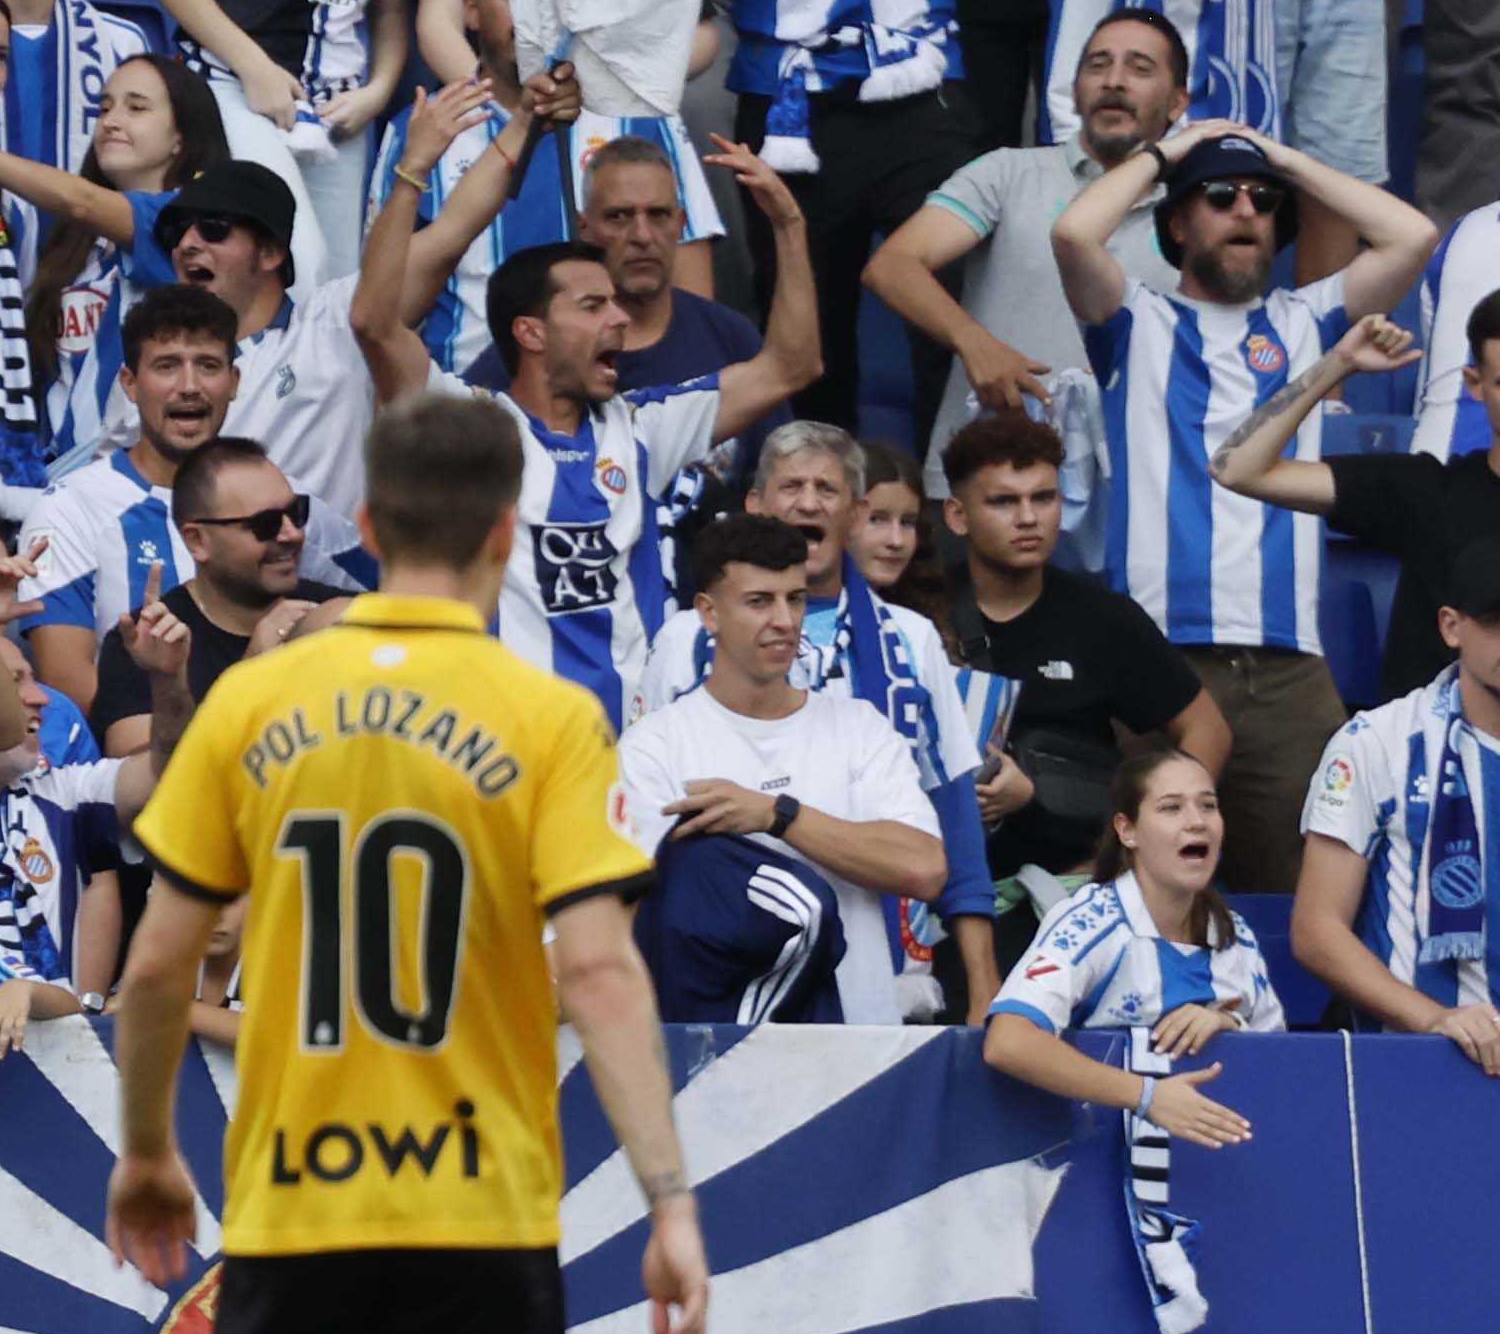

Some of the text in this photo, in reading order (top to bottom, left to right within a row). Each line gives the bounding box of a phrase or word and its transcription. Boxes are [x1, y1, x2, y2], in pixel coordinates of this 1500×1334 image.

[243, 687, 521, 799] POL LOZANO
[273, 807, 471, 1053] 10
